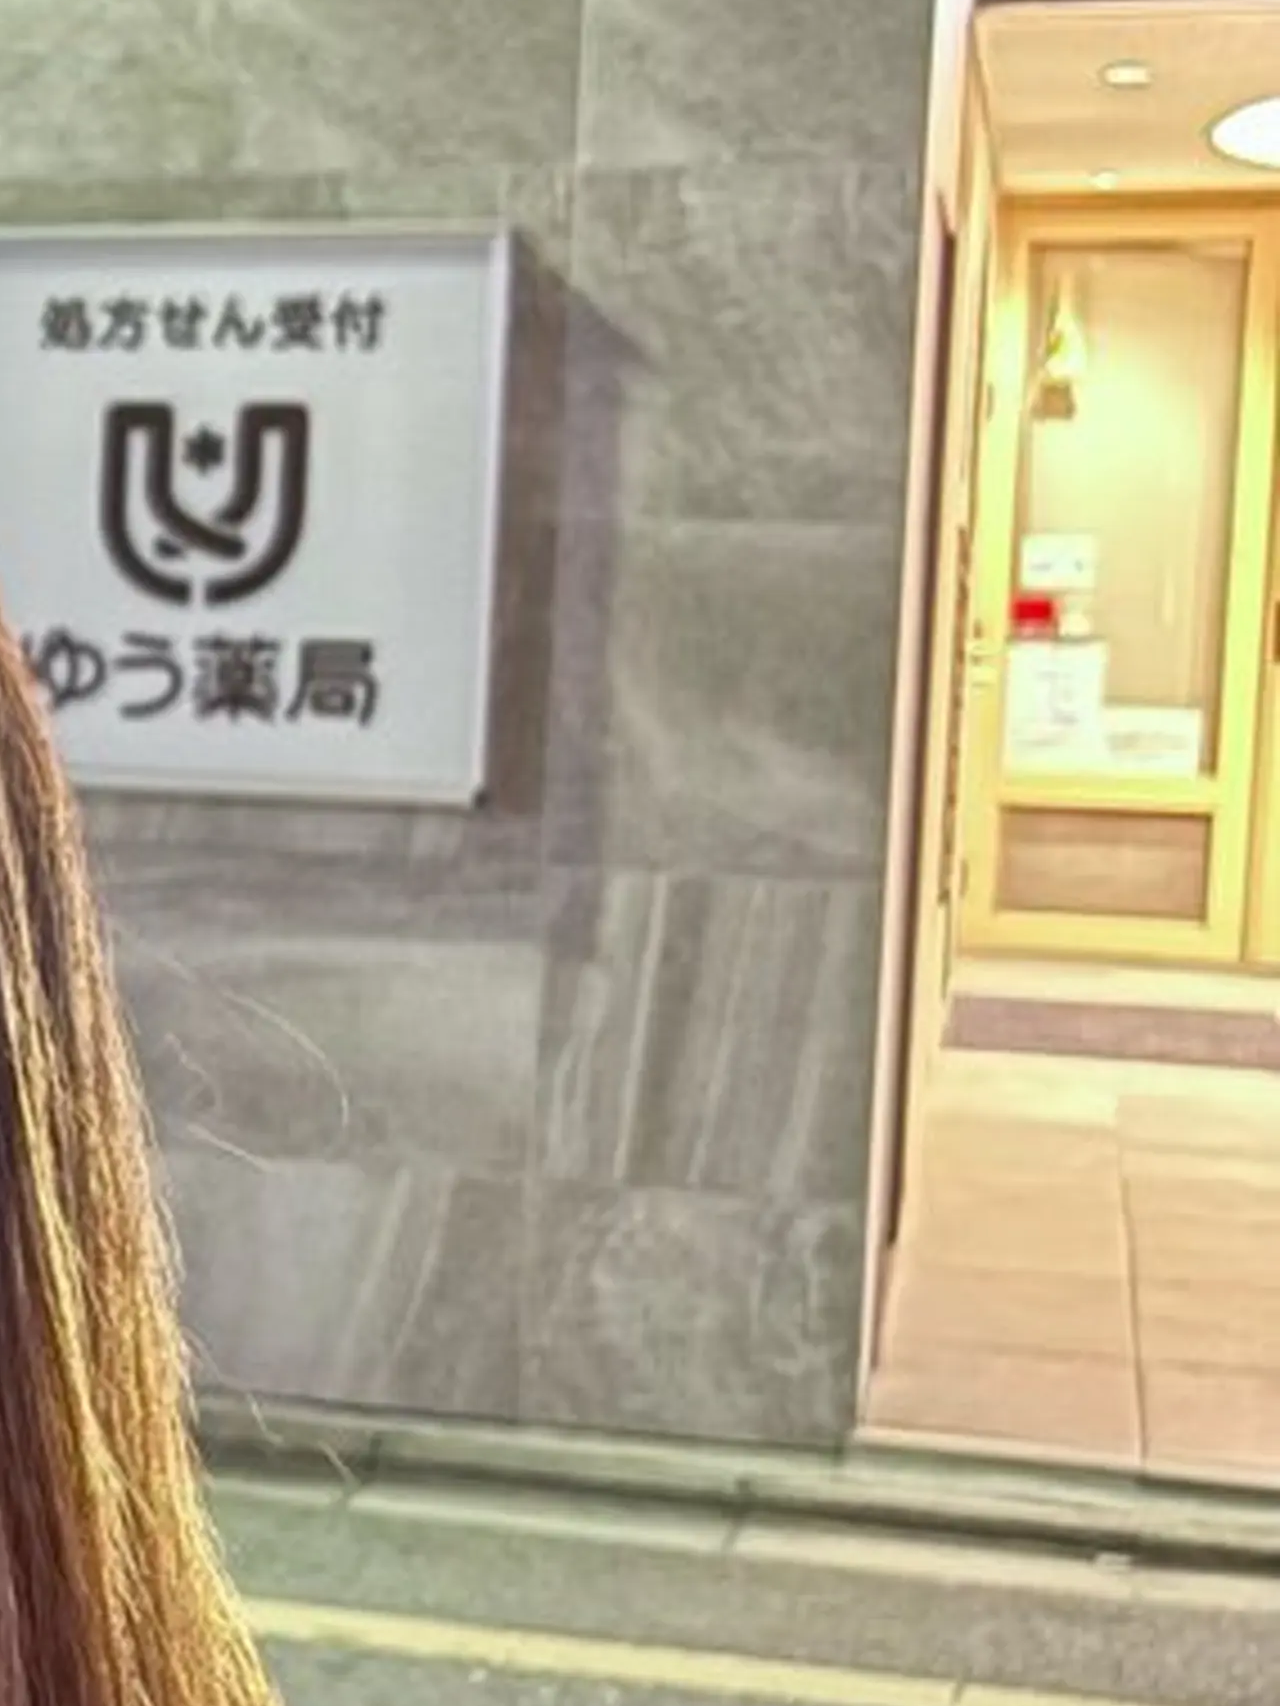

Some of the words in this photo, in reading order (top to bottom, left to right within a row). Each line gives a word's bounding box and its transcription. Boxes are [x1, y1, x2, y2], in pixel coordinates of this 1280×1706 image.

[38, 292, 384, 353] 処方せん受付
[22, 625, 380, 727] ゆう薬局
